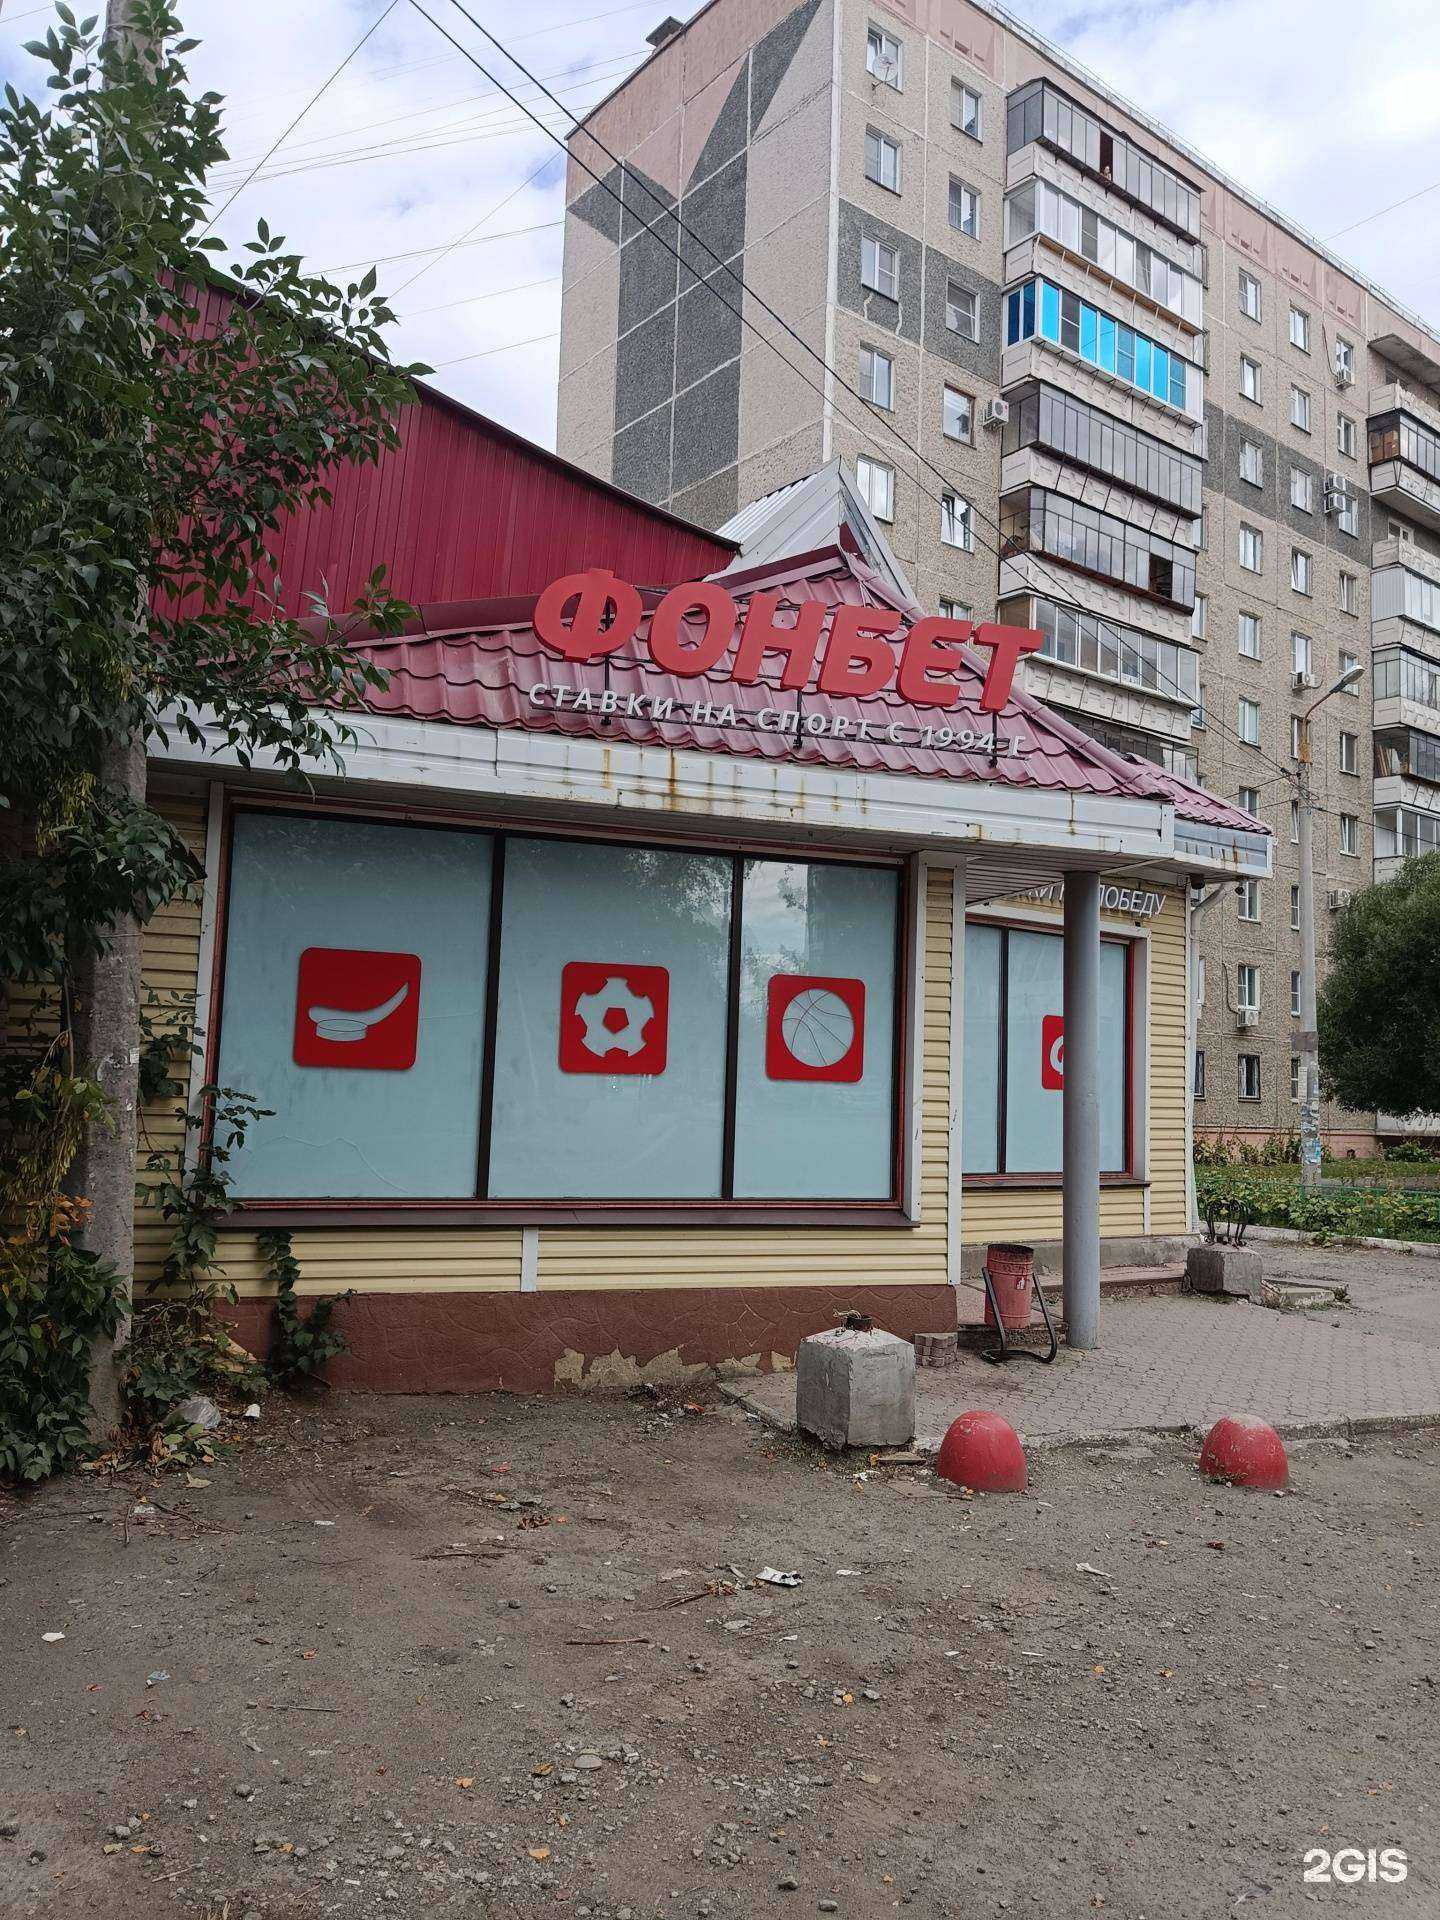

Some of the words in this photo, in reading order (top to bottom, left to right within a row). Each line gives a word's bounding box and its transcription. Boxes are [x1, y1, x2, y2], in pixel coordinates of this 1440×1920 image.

[533, 568, 1044, 714] ФОНБЕТ
[529, 683, 674, 719] СТАВКИ
[691, 701, 737, 726] НА
[754, 707, 873, 741] СПОРТ
[886, 721, 904, 743] С
[919, 725, 995, 752] 1994
